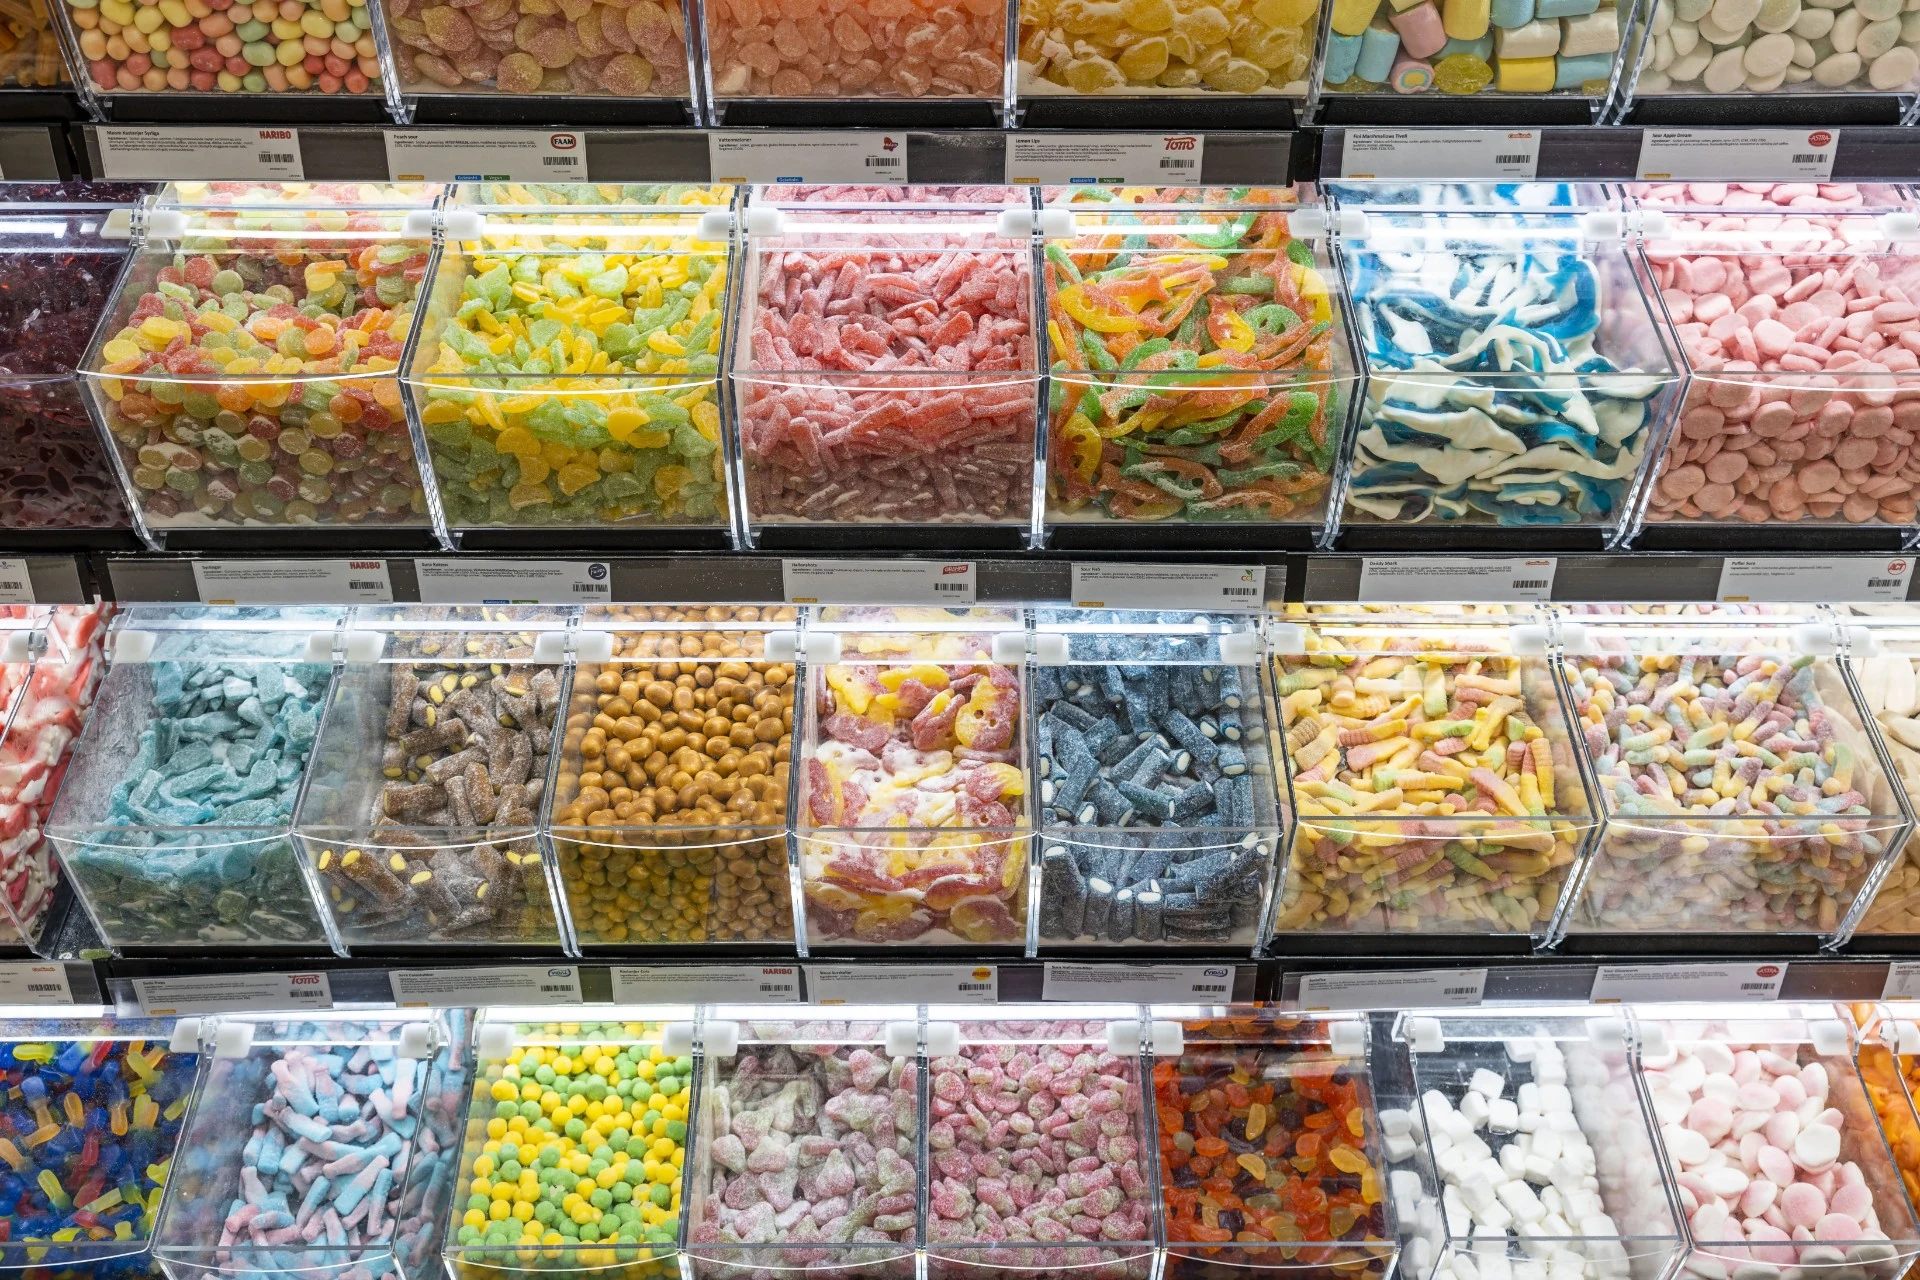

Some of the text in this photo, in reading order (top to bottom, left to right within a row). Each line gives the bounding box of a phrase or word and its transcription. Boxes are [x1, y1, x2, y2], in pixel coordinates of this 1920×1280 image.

[260, 131, 291, 139] HARIBO
[1164, 137, 1196, 150] Toms
[288, 975, 320, 984] Toms
